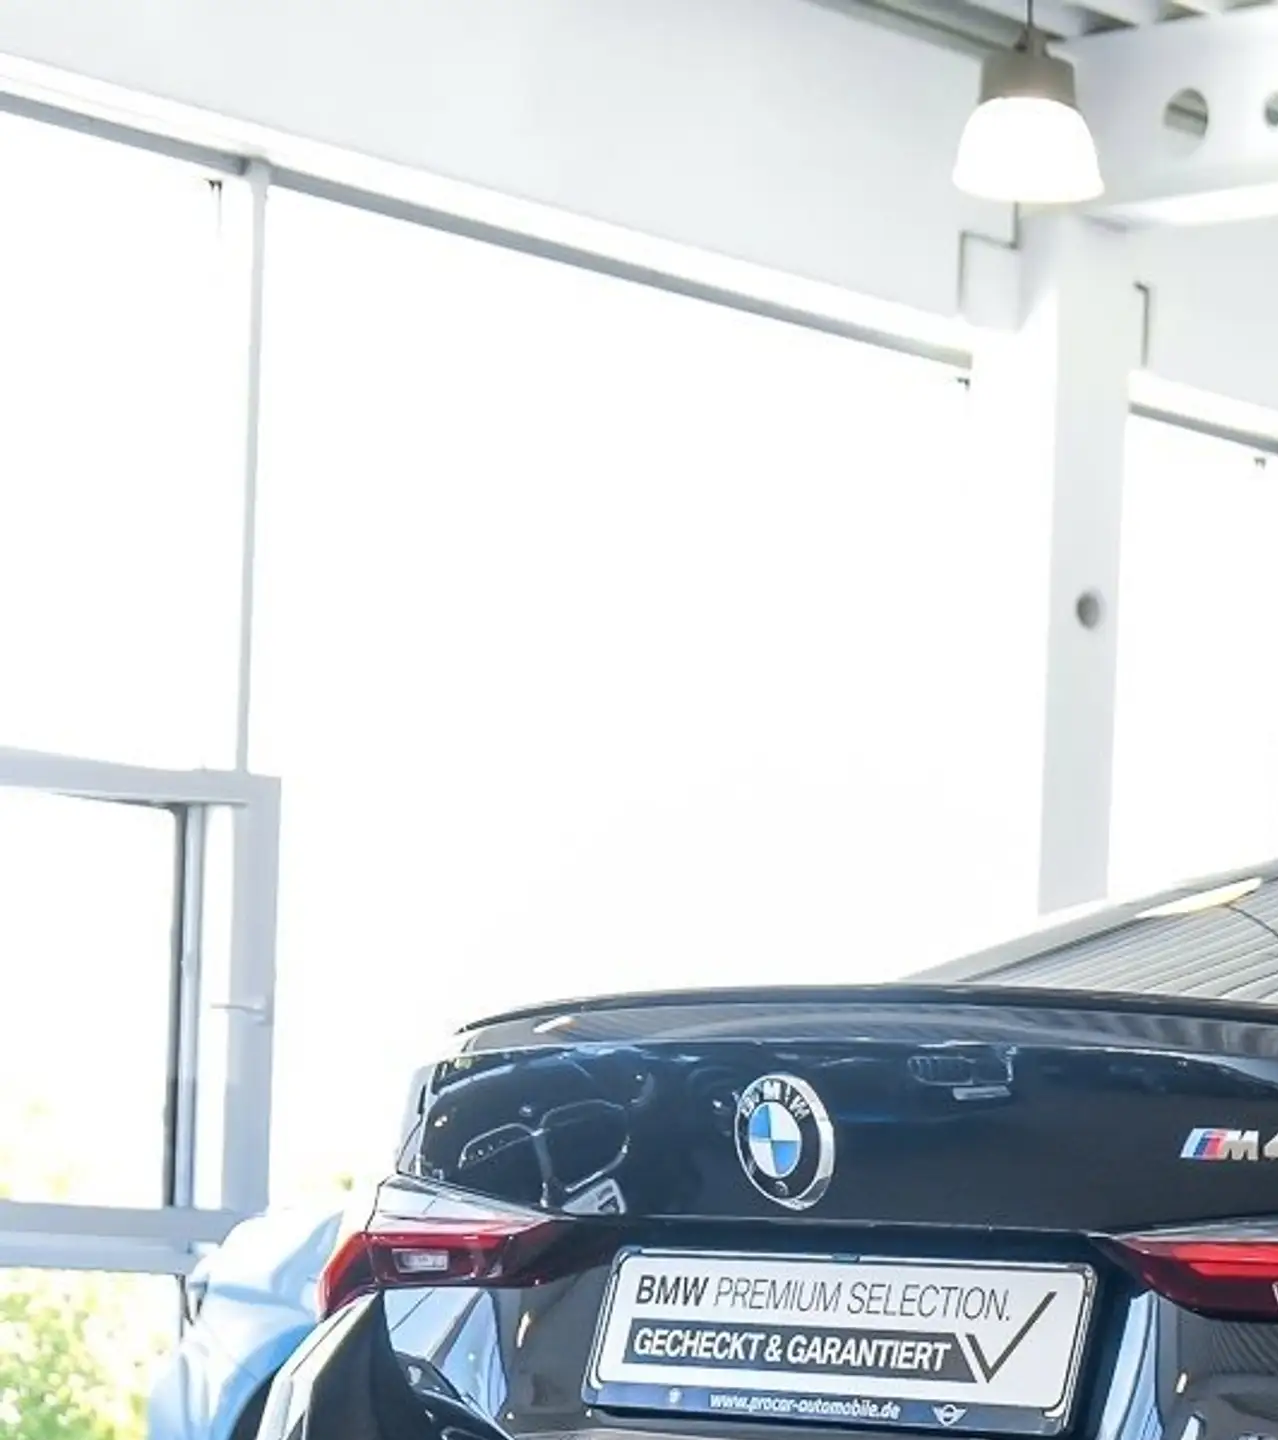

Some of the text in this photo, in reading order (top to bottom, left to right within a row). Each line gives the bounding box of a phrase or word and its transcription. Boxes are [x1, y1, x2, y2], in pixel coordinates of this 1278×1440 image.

[740, 1078, 811, 1120] BMW
[635, 1274, 1011, 1322] BMW PREMIUM SELECTION.
[633, 1327, 951, 1372] GECHECKT & GARANTIERT
[709, 1391, 901, 1421] www.procar-automobile.de
